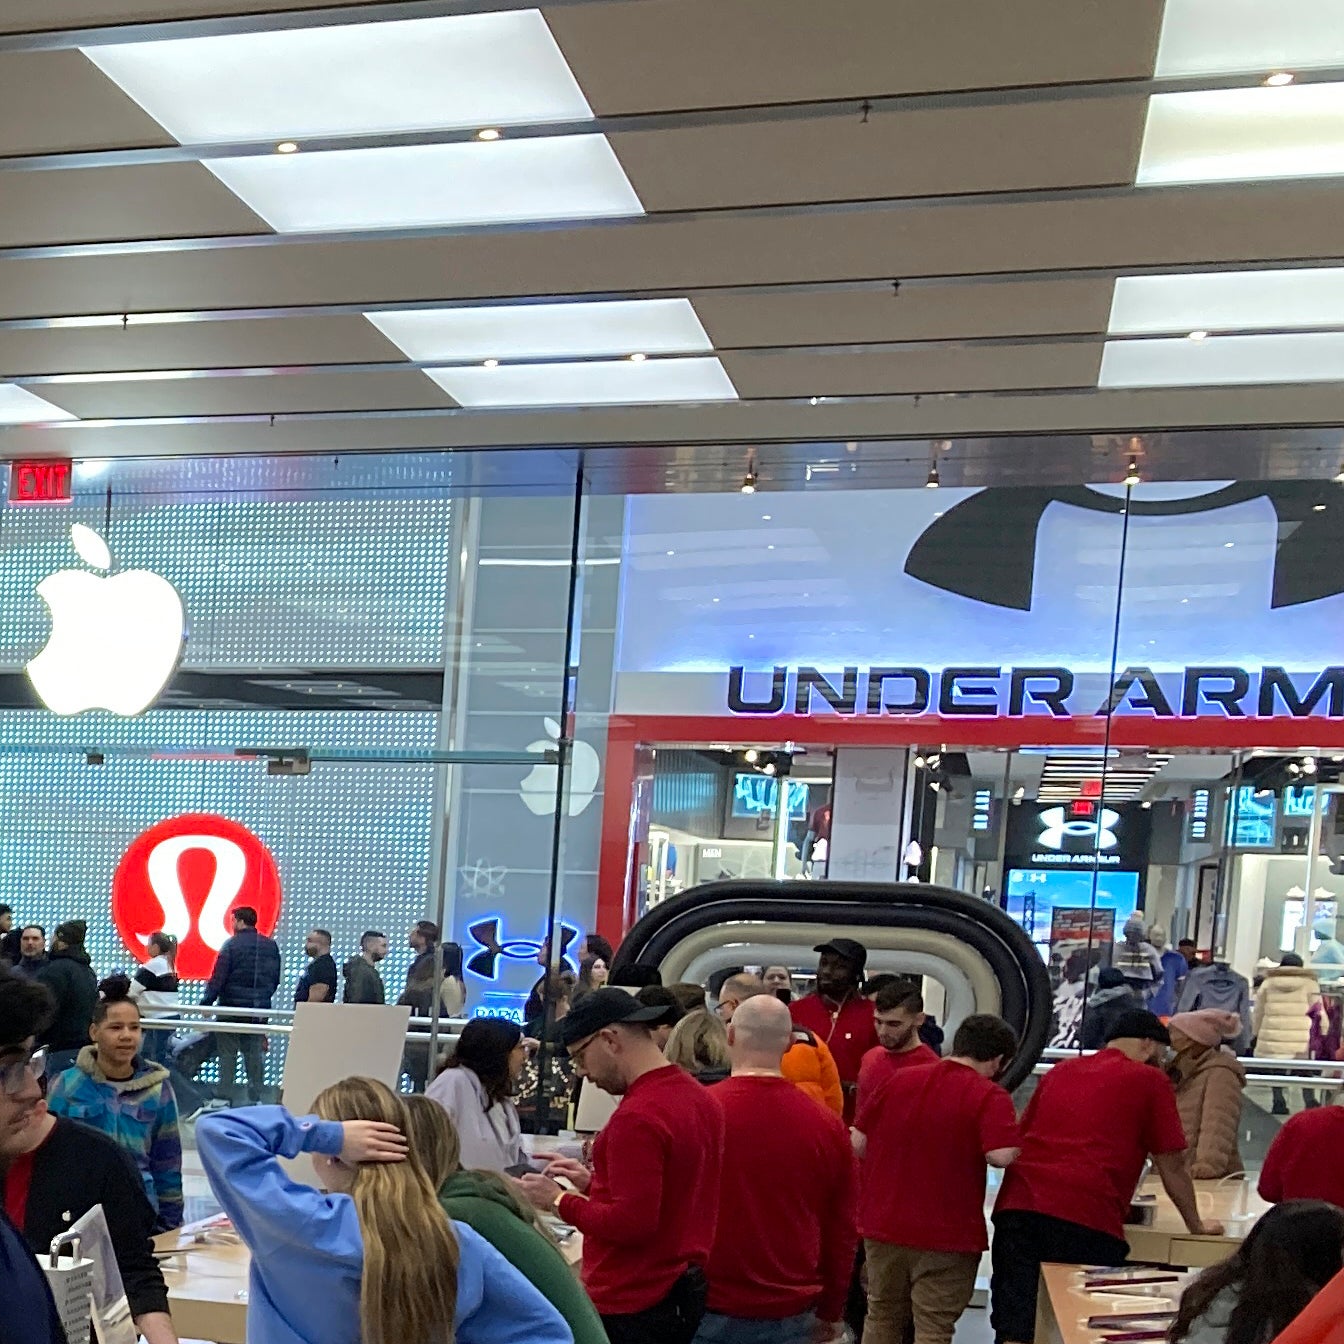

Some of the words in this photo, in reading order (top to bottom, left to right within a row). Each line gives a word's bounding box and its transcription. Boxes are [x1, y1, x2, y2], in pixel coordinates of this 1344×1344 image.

[17, 464, 69, 499] EXIT
[726, 665, 1075, 716] UNDER
[1093, 665, 1344, 719] ARM
[702, 848, 722, 858] MEN
[1031, 853, 1072, 864] UNDER
